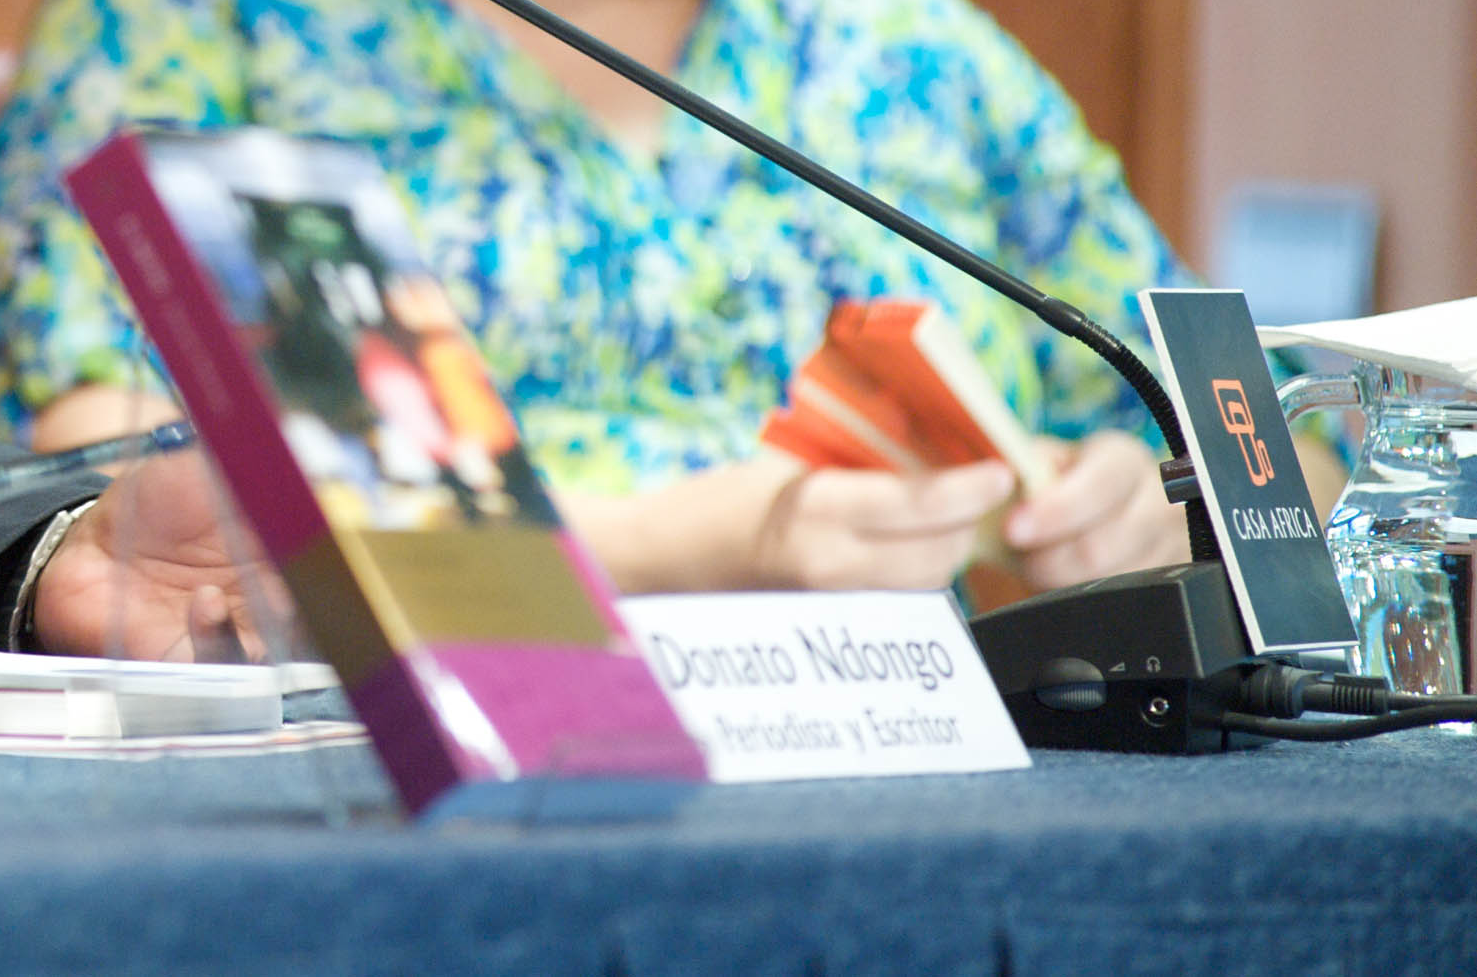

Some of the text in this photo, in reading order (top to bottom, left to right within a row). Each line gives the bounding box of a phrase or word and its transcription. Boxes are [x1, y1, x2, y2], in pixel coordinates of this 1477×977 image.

[1232, 506, 1318, 540] CASA AFRICA
[650, 626, 954, 691] Donato Ndongo
[844, 720, 867, 755] y
[864, 706, 963, 748] Escritor
